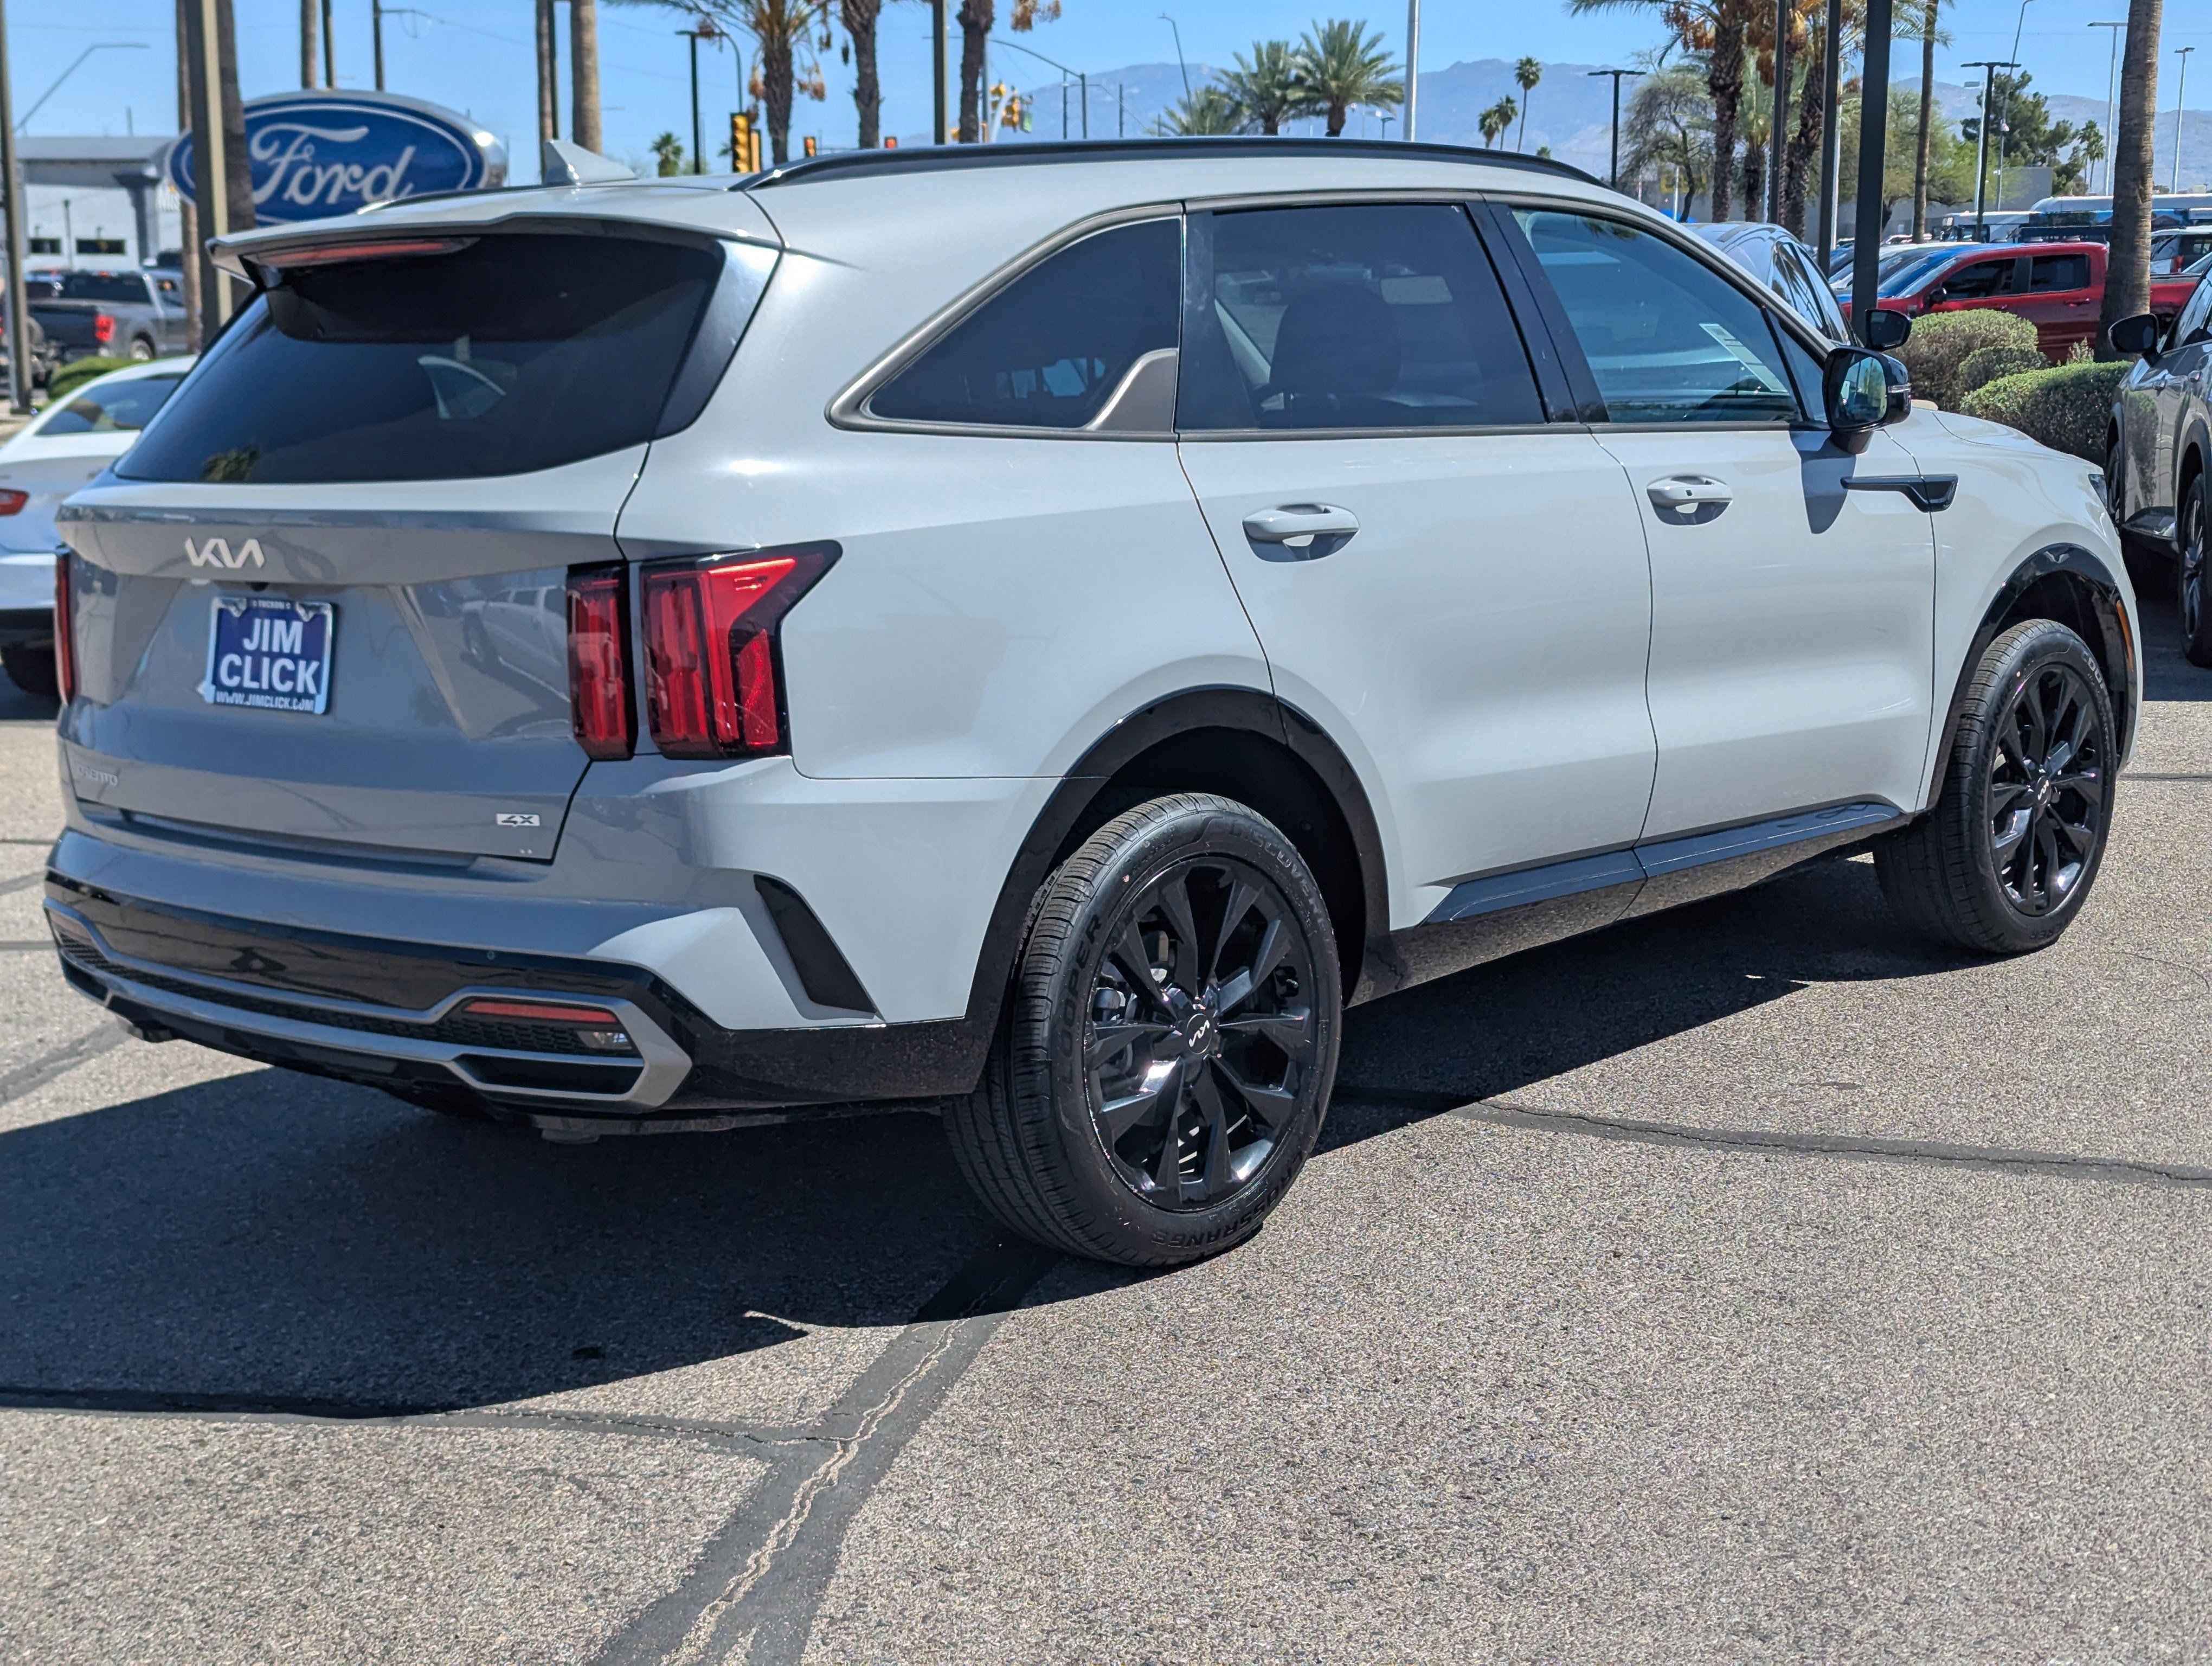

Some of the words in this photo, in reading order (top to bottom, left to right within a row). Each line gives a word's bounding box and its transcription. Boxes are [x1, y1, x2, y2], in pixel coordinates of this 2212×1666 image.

[250, 123, 417, 206] Ford
[184, 537, 266, 568] KIA
[242, 618, 304, 654] JIM
[220, 653, 320, 695] CLICK
[1059, 913, 1102, 1087] COOPER
